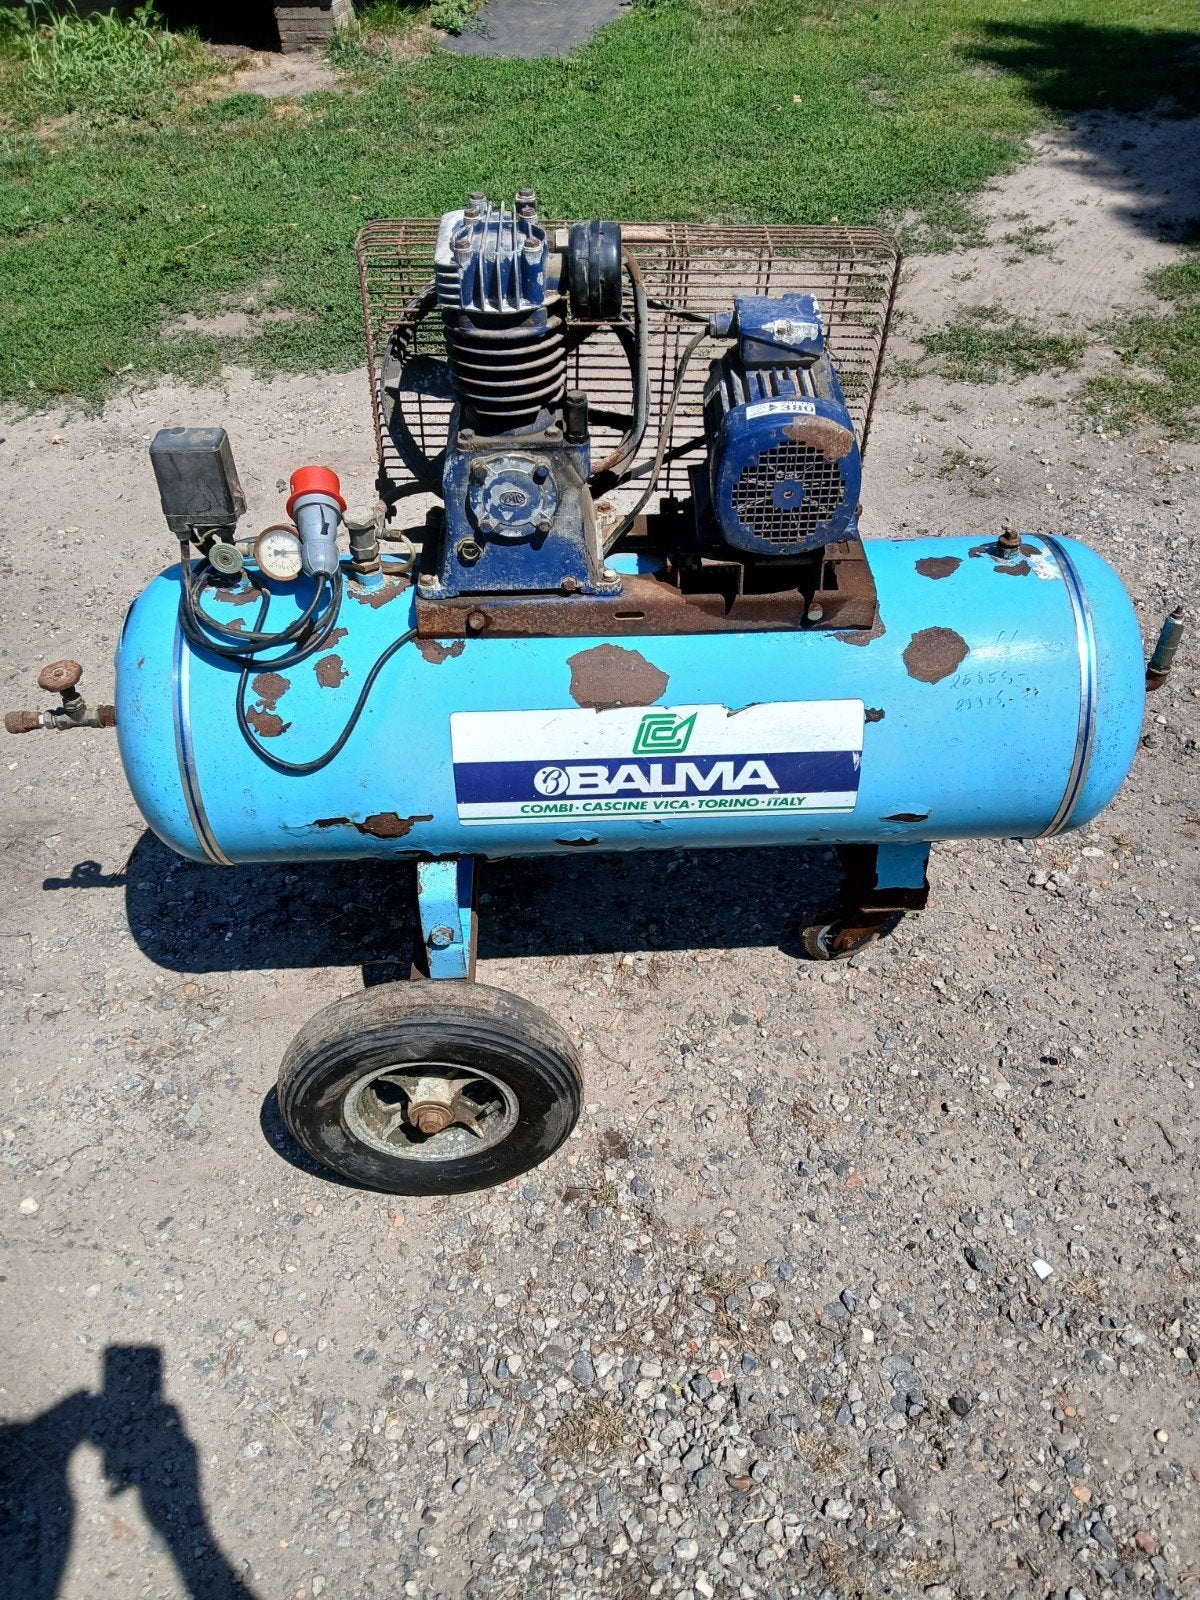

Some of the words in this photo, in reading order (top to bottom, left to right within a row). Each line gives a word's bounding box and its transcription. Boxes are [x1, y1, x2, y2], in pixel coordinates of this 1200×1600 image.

[565, 760, 780, 796] BALMA
[521, 803, 574, 814] COMBI
[582, 801, 648, 812] CASCINE
[653, 799, 690, 810] VICA
[697, 797, 759, 809] TORINO
[766, 796, 807, 807] ITALY
